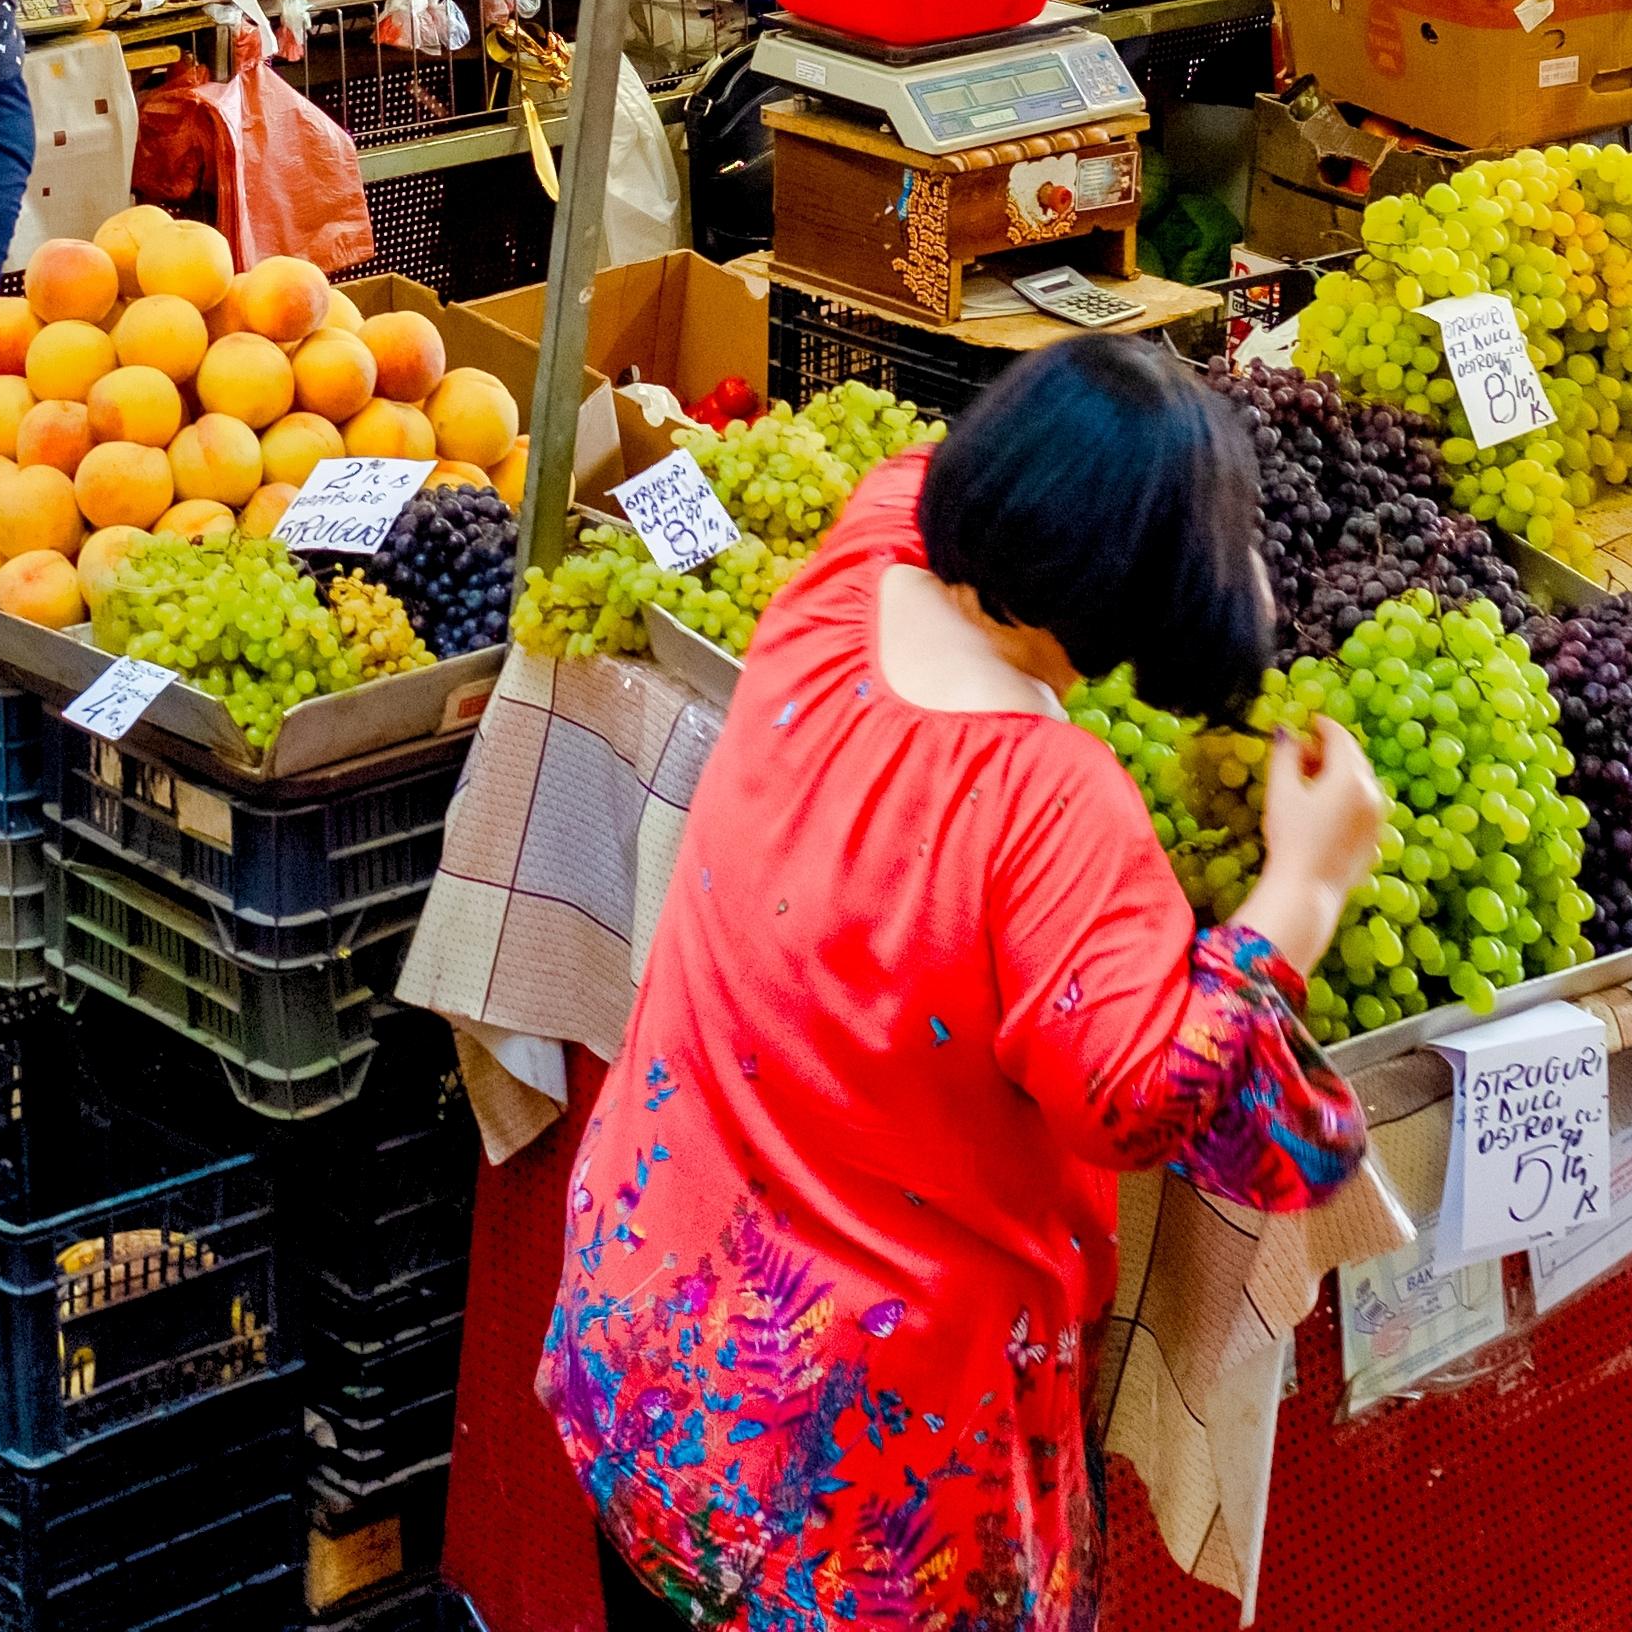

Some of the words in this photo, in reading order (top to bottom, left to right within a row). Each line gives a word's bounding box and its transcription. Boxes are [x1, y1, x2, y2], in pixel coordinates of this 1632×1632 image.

[1484, 372, 1517, 424] 8
[323, 461, 363, 491] 2
[1473, 1046, 1603, 1102] STRUGURI
[1498, 1089, 1563, 1124] DULCI
[1478, 1116, 1566, 1155] OSTROV
[1508, 1144, 1559, 1223] 5
